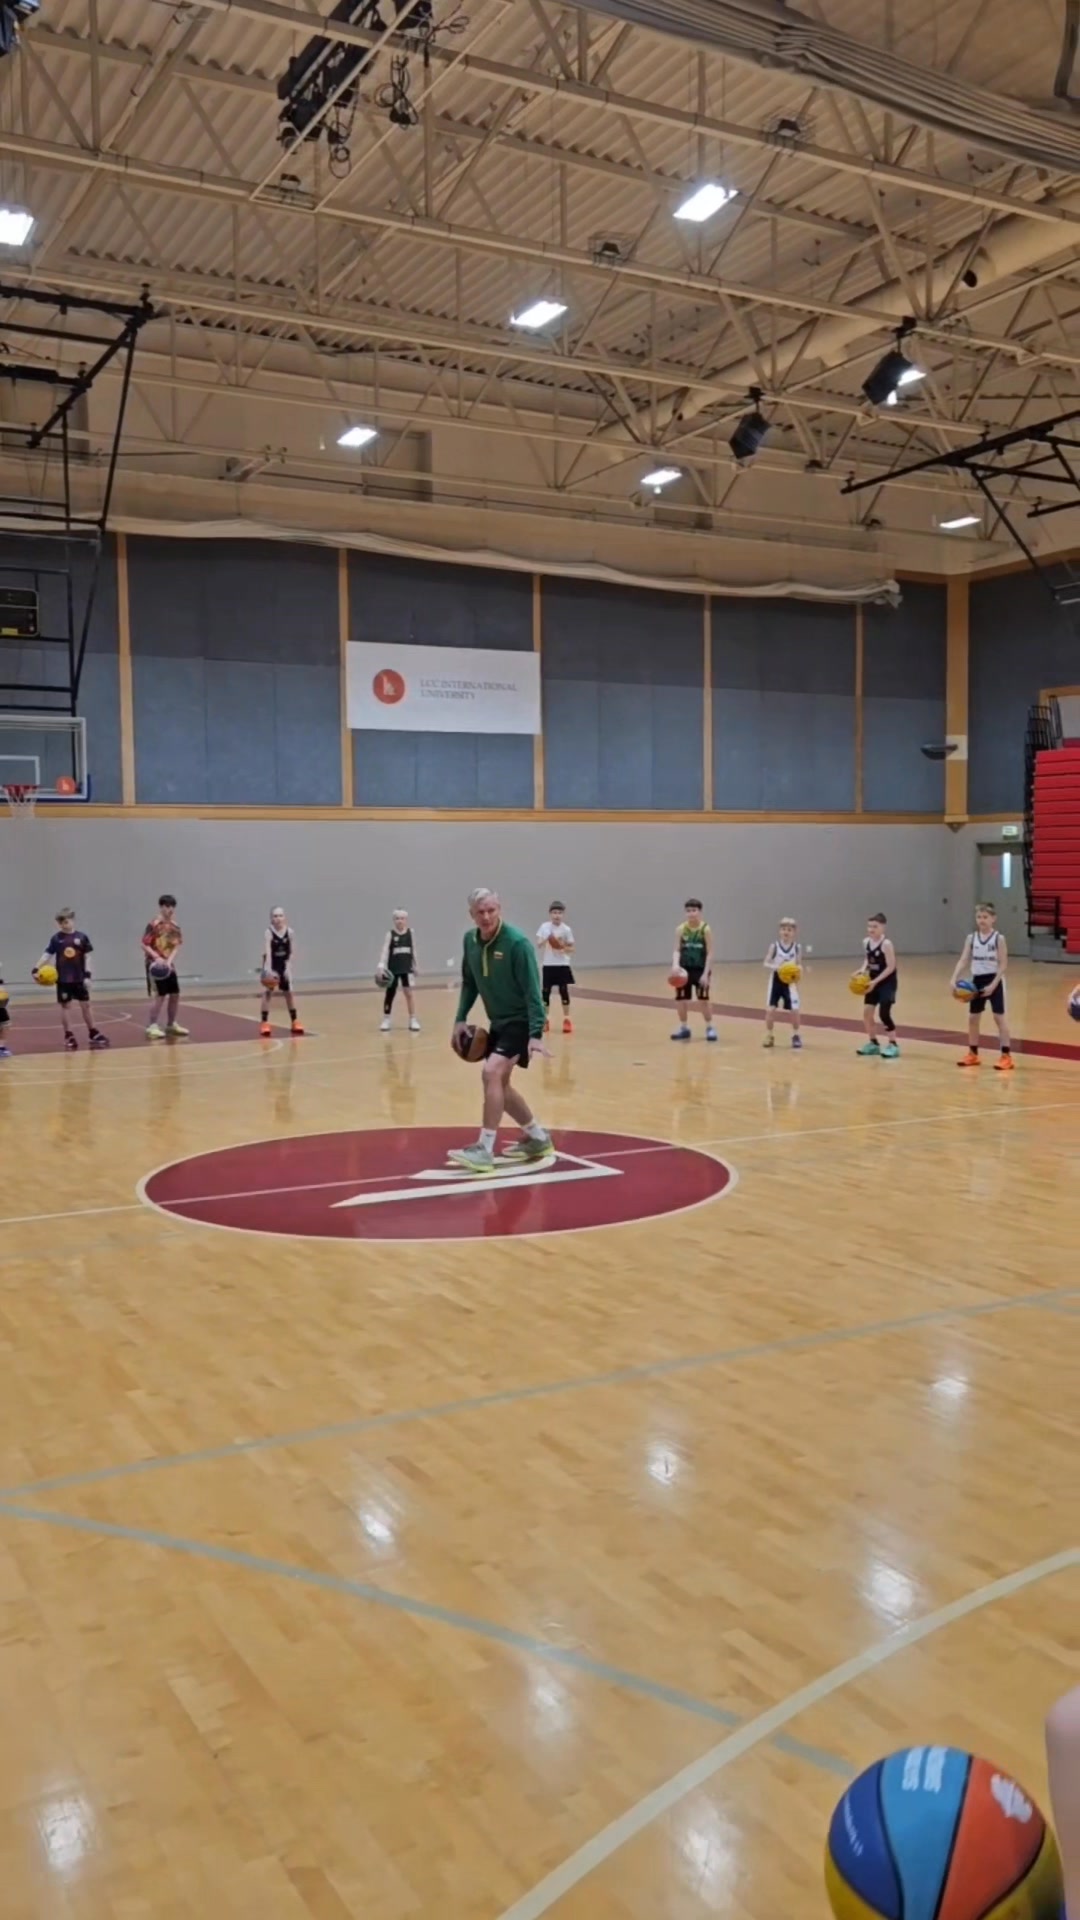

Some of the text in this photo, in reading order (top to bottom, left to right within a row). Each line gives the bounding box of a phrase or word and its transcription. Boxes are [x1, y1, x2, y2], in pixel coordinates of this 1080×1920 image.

[420, 679, 518, 691] LCC INTERNATIONAL
[420, 689, 475, 700] UNIVERSITY
